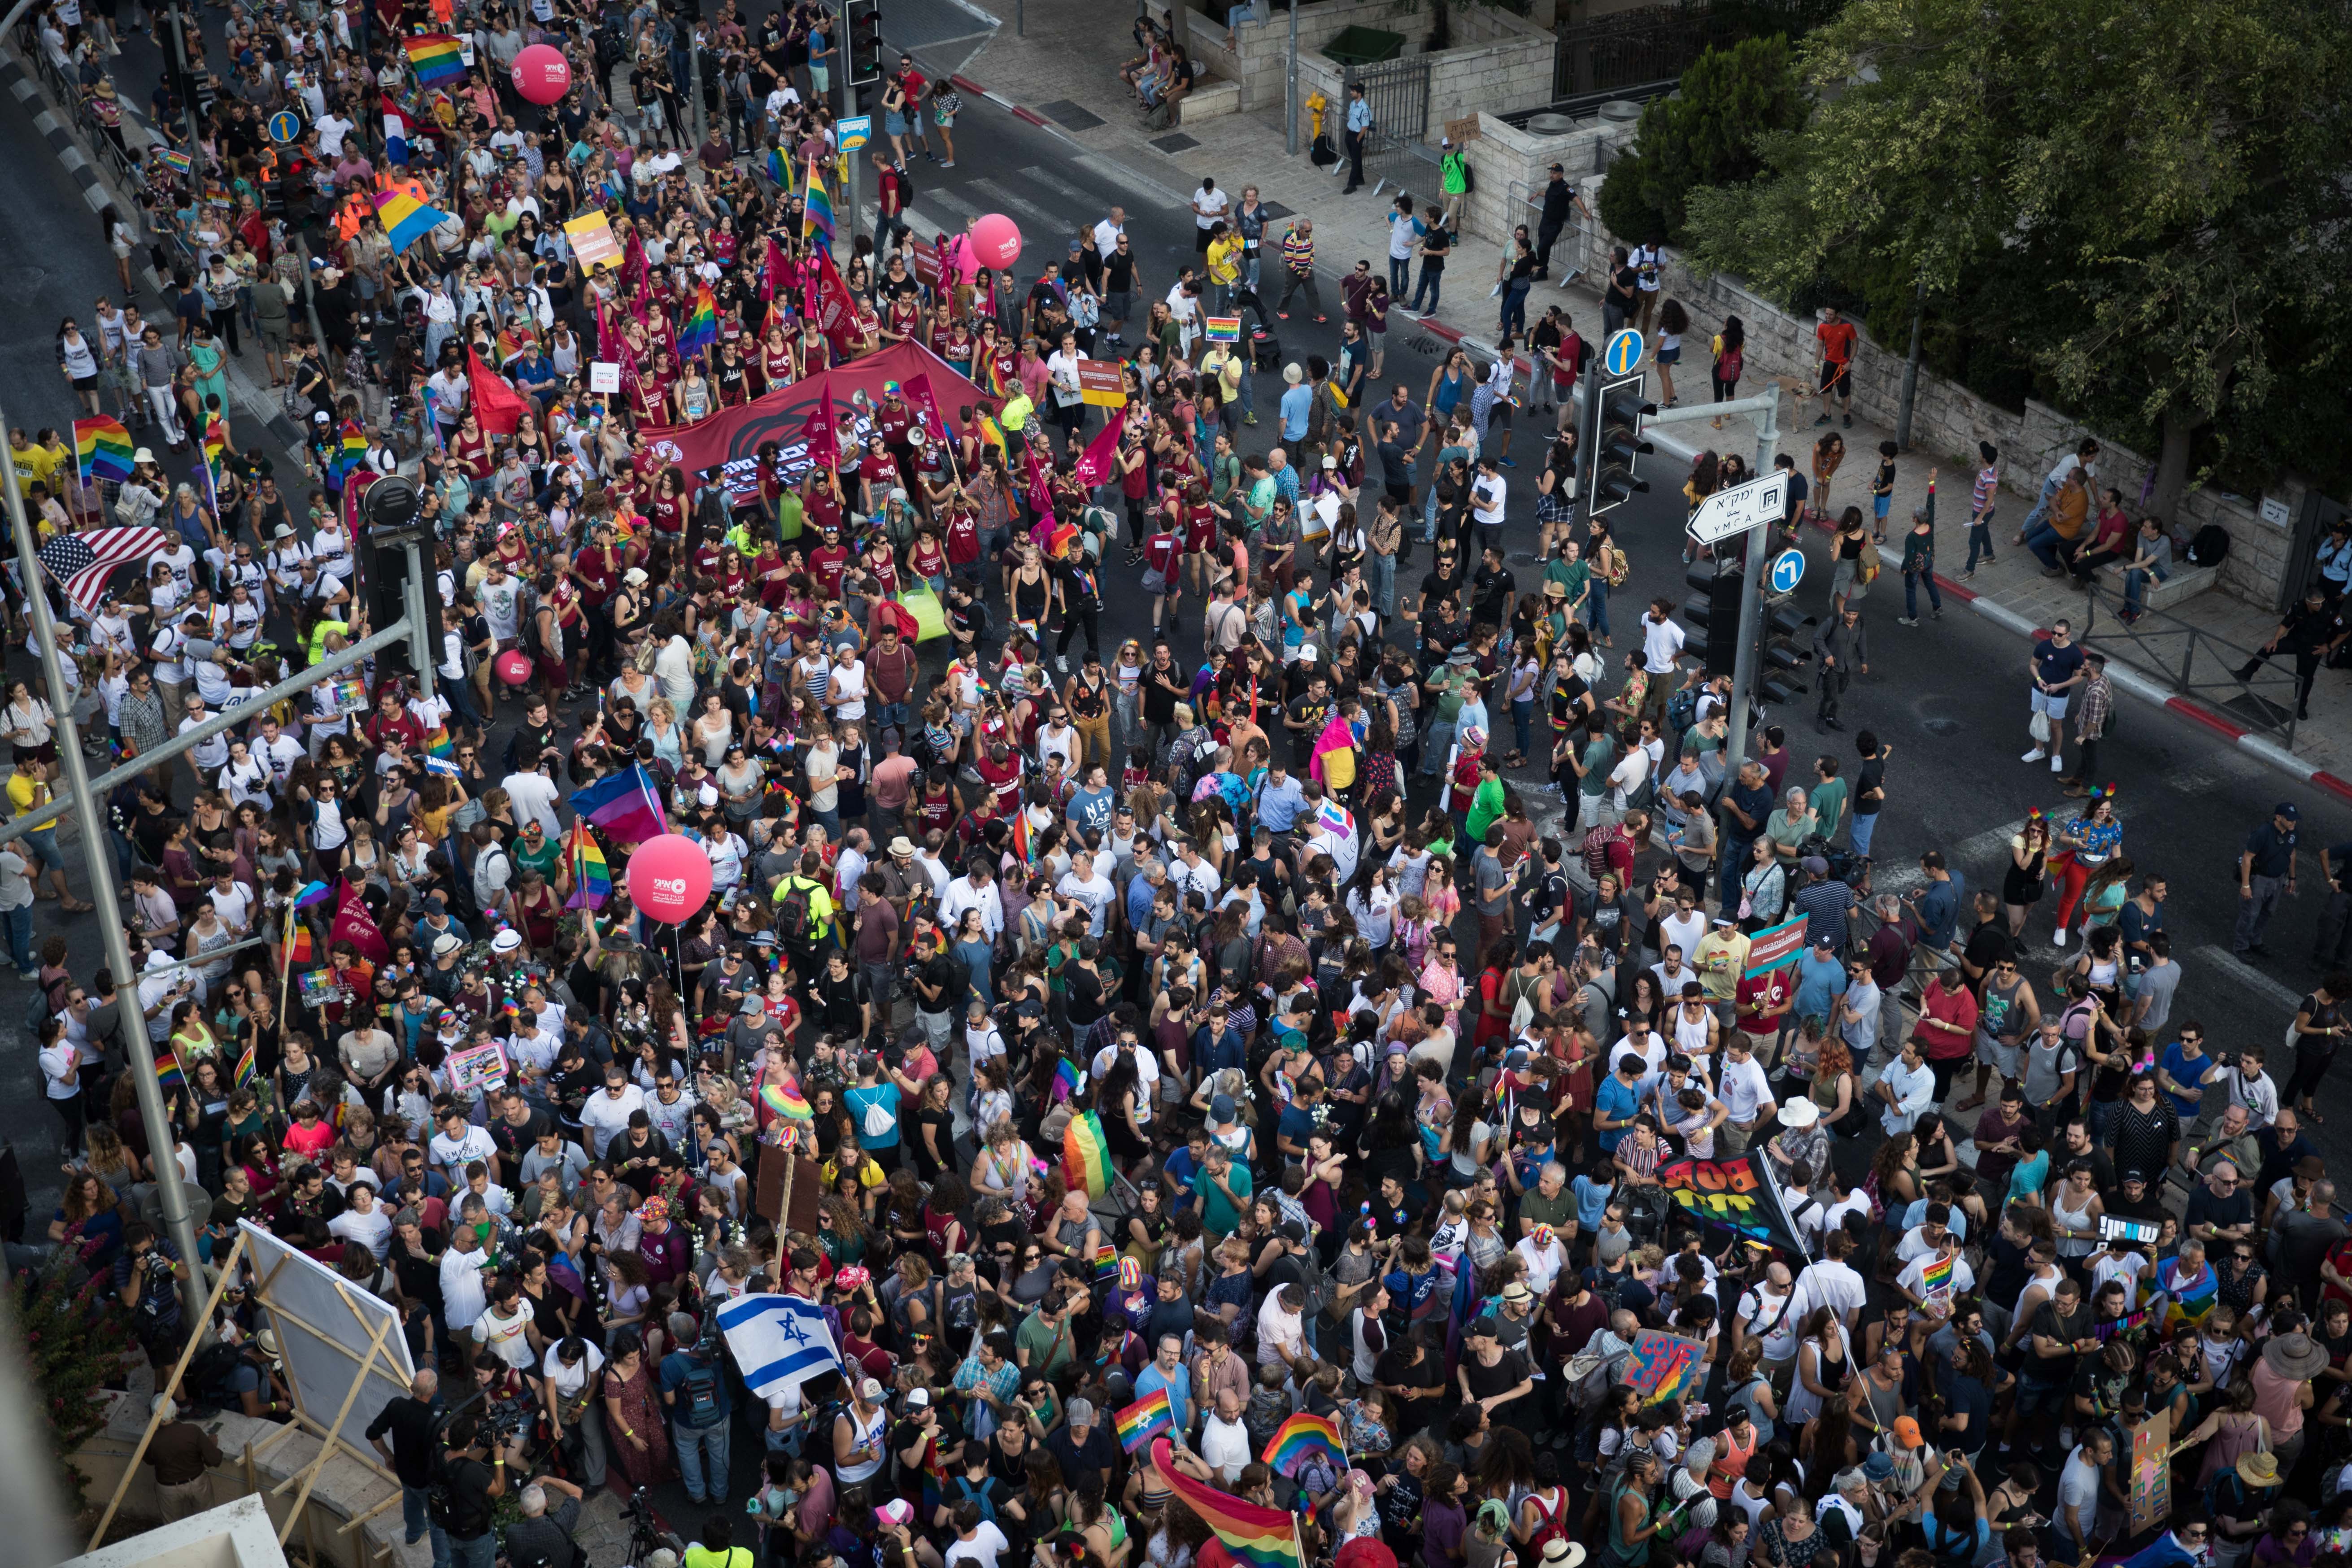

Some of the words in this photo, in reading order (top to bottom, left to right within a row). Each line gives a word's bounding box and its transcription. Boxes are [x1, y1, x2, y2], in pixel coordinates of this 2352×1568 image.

[1079, 464, 1096, 475] בלי
[1716, 488, 1753, 510] ימק"א
[1085, 793, 1112, 814] NEW
[654, 878, 671, 889] איגי
[307, 975, 327, 983] גאווה
[313, 996, 331, 1004] בושה
[1640, 1335, 1697, 1364] LOVE
[1651, 1357, 1668, 1373] IS
[1353, 1475, 1367, 1488] W
